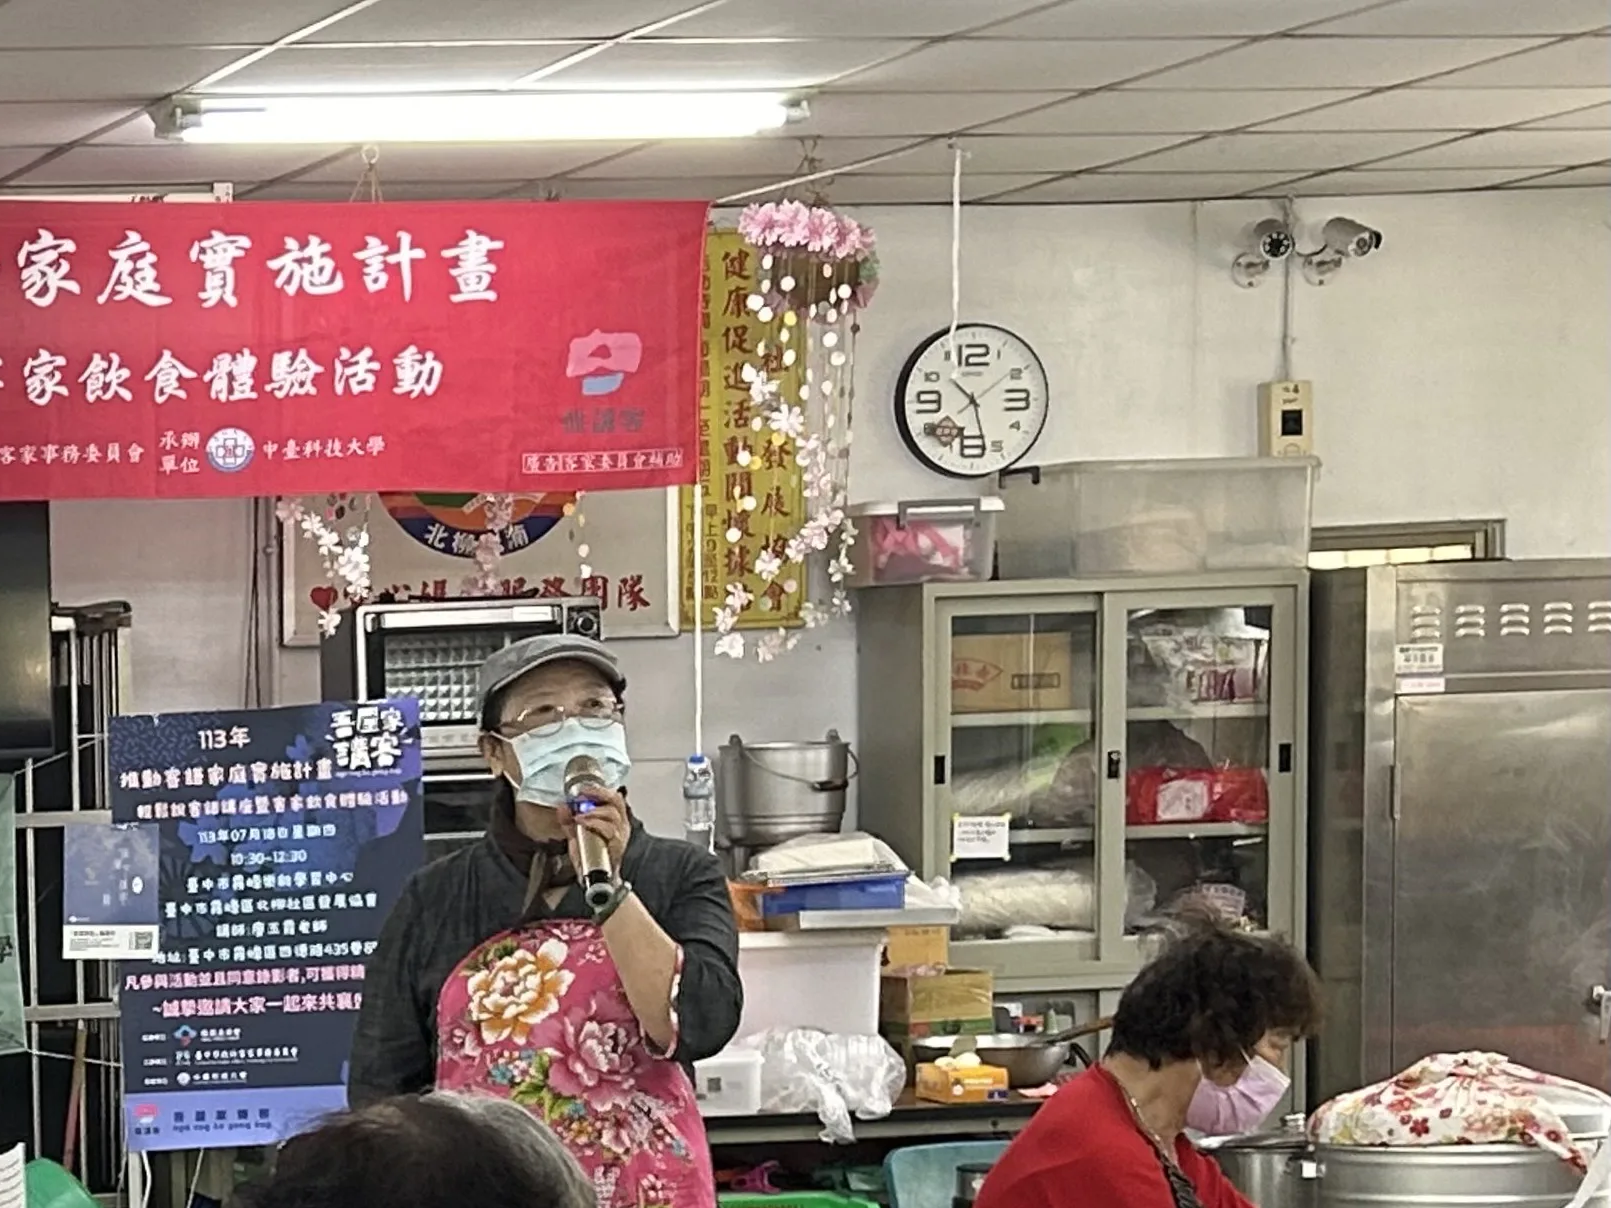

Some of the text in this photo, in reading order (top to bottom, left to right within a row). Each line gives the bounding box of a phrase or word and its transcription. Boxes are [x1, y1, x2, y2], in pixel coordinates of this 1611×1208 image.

[958, 344, 990, 367] 12
[916, 390, 941, 414] 9
[1004, 389, 1030, 411] 3
[1009, 421, 1021, 431] 4
[262, 434, 386, 461] 中臺科技大學
[198, 726, 251, 750] 113年
[119, 758, 333, 790] 推動客語家庭實施計畫
